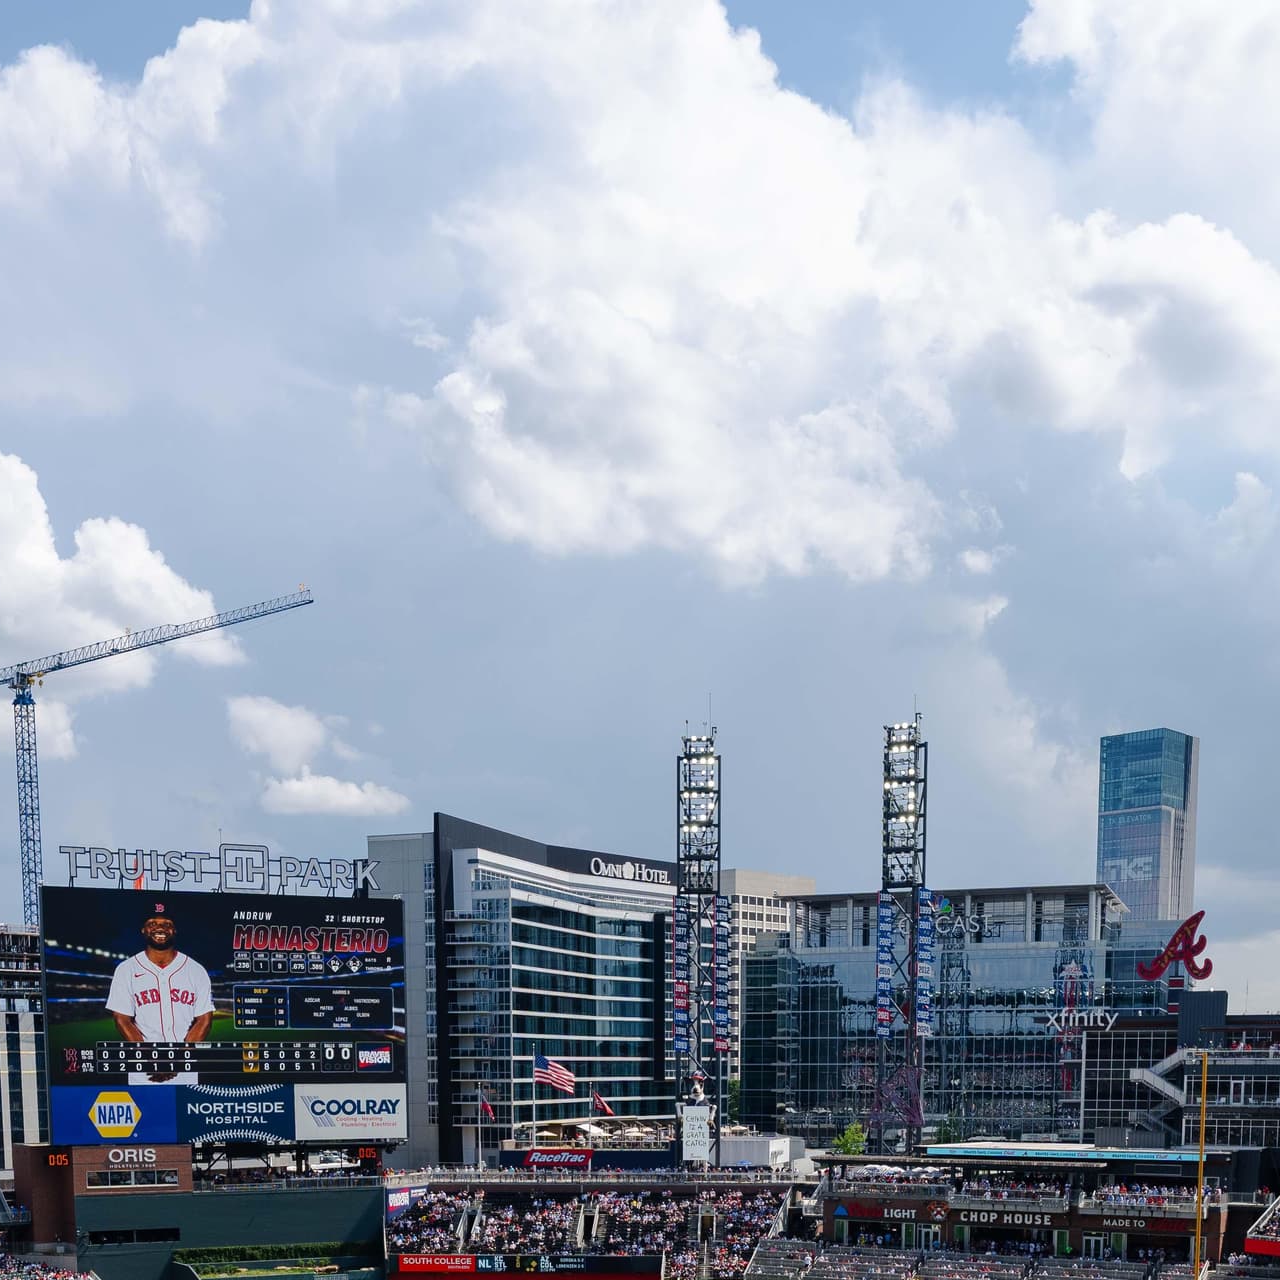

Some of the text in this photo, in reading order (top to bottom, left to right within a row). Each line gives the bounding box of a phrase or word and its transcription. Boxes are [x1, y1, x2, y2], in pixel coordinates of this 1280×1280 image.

[59, 845, 381, 890] TRUIST PARK
[590, 857, 671, 885] OMNI HOTEL
[233, 911, 273, 921] ANDRUW
[233, 924, 390, 953] MONASTERIO
[1046, 1007, 1119, 1032] xfinity
[187, 1102, 285, 1115] NORTHSIDE
[310, 1099, 401, 1116] COOLRAY
[98, 1105, 133, 1124] NAPA
[205, 1116, 268, 1125] HOSPITAL
[108, 1149, 157, 1163] ORIS
[528, 1152, 587, 1164] RaceTrac
[883, 1208, 917, 1220] LIGHT
[960, 1211, 1052, 1226] CHOP HOUSE
[1103, 1218, 1130, 1228] MADE
[1132, 1219, 1146, 1229] TO
[402, 1257, 472, 1265] SOUTH COLLEGE
[478, 1260, 492, 1269] NL
